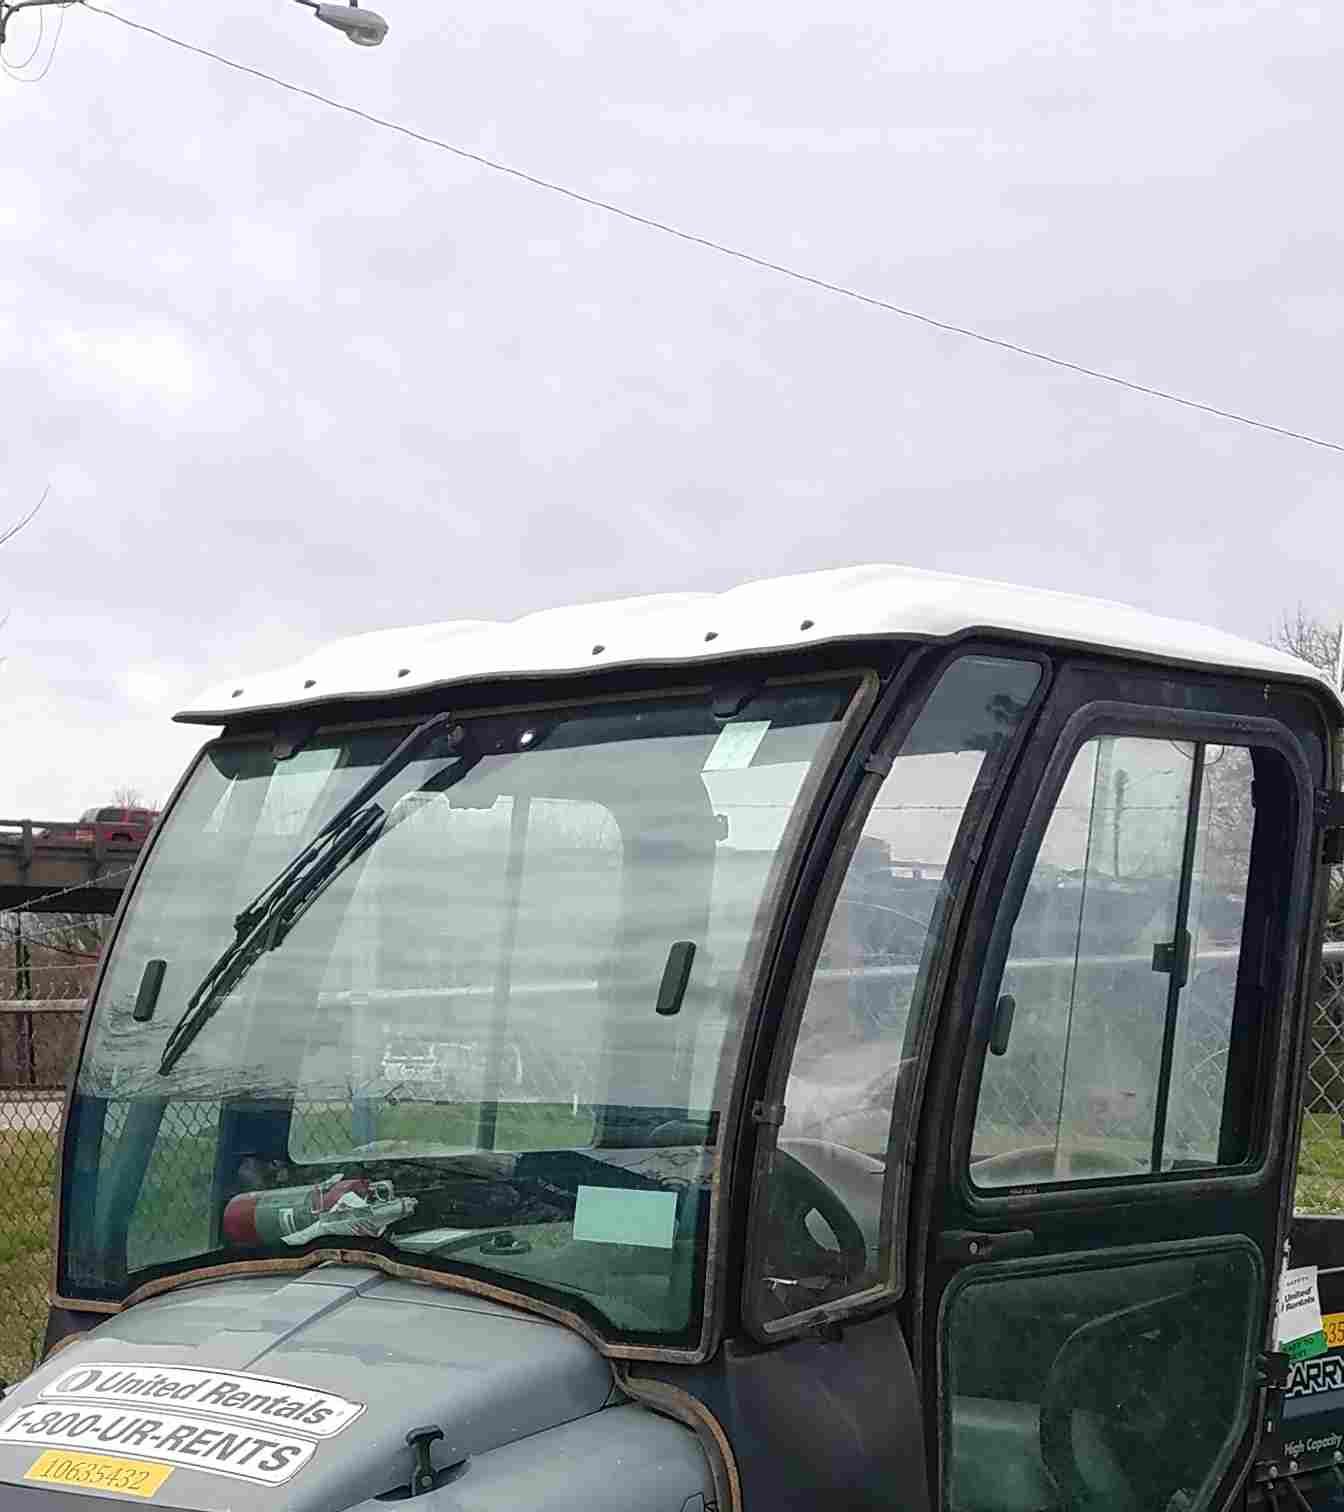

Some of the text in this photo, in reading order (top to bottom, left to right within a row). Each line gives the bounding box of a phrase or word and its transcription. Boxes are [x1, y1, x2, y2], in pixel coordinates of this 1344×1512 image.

[95, 1370, 334, 1425] United Rentals
[5, 1408, 303, 1472] 1-800-UR-RENTS
[1306, 1431, 1343, 1453] Capacity
[38, 1457, 151, 1491] 10635432
